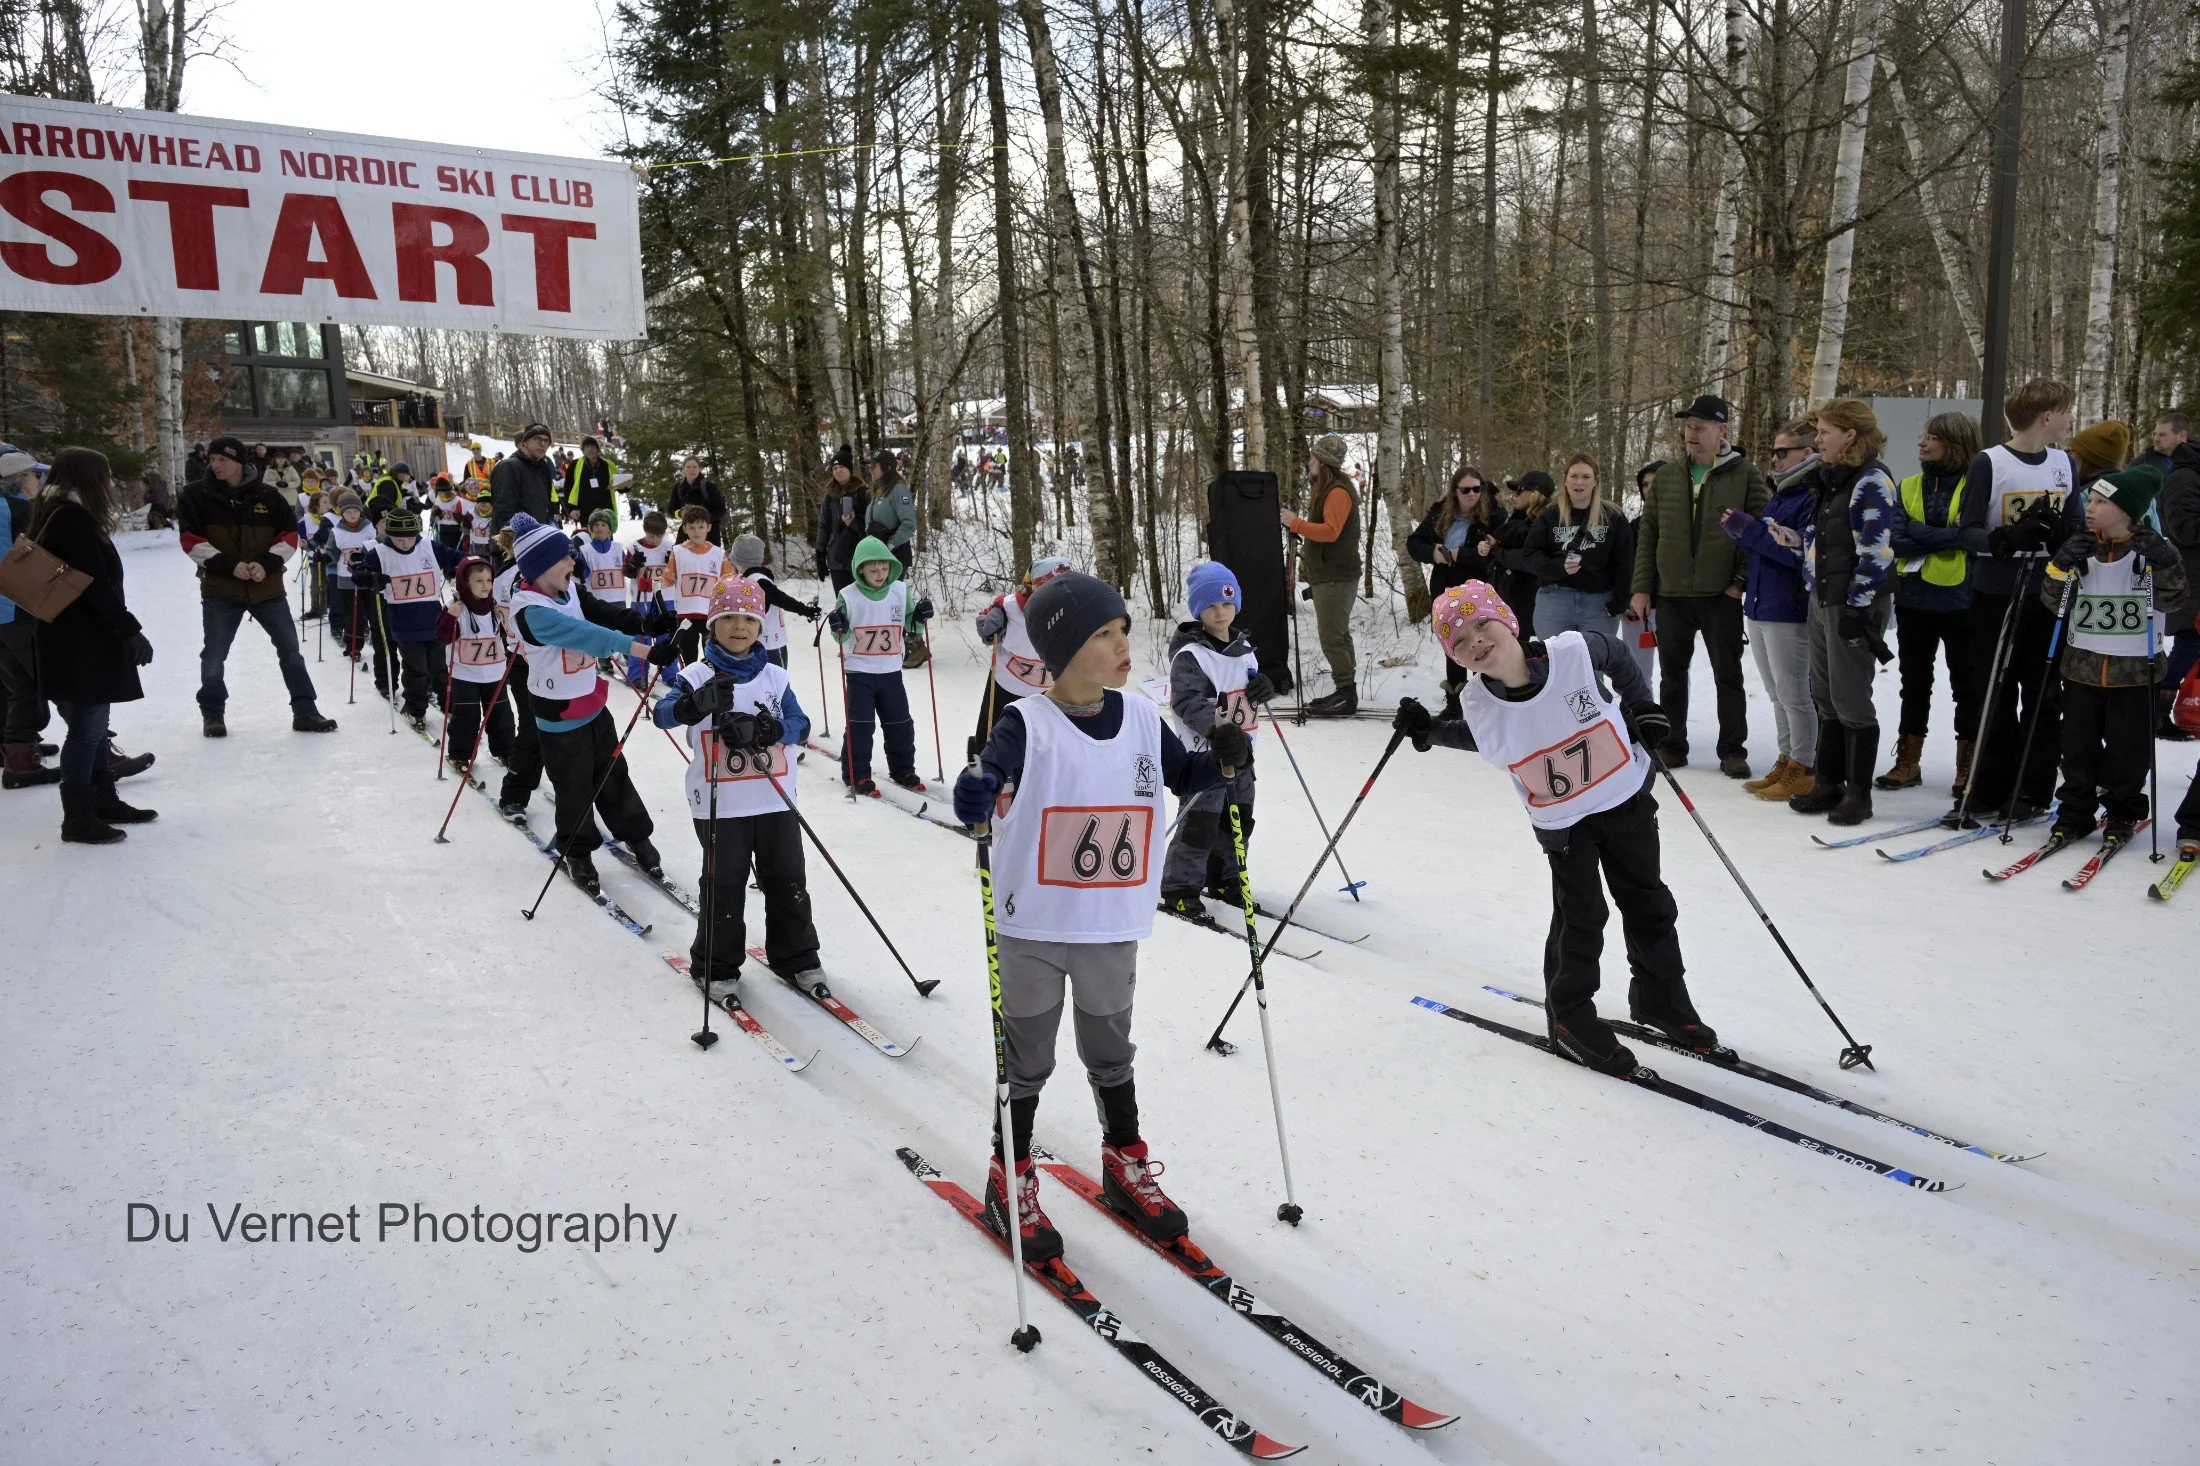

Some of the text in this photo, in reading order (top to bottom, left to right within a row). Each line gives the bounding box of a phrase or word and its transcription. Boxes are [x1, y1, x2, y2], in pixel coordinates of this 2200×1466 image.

[281, 149, 420, 189] NORDIC
[437, 165, 496, 198] SKI
[511, 173, 594, 209] CLUB
[0, 170, 597, 313] START
[401, 577, 426, 597] 76
[597, 572, 614, 587] 81
[689, 576, 708, 594] 77
[2076, 599, 2143, 632] 238
[471, 641, 498, 662] 74
[865, 629, 893, 652] 73
[1019, 661, 1048, 685] 71
[1231, 693, 1258, 727] 69
[1544, 734, 1593, 800] 67
[1071, 813, 1136, 882] 66
[1282, 1333, 1344, 1378] ROSSIGNOL
[1143, 1361, 1200, 1408] ROSSIGNOL
